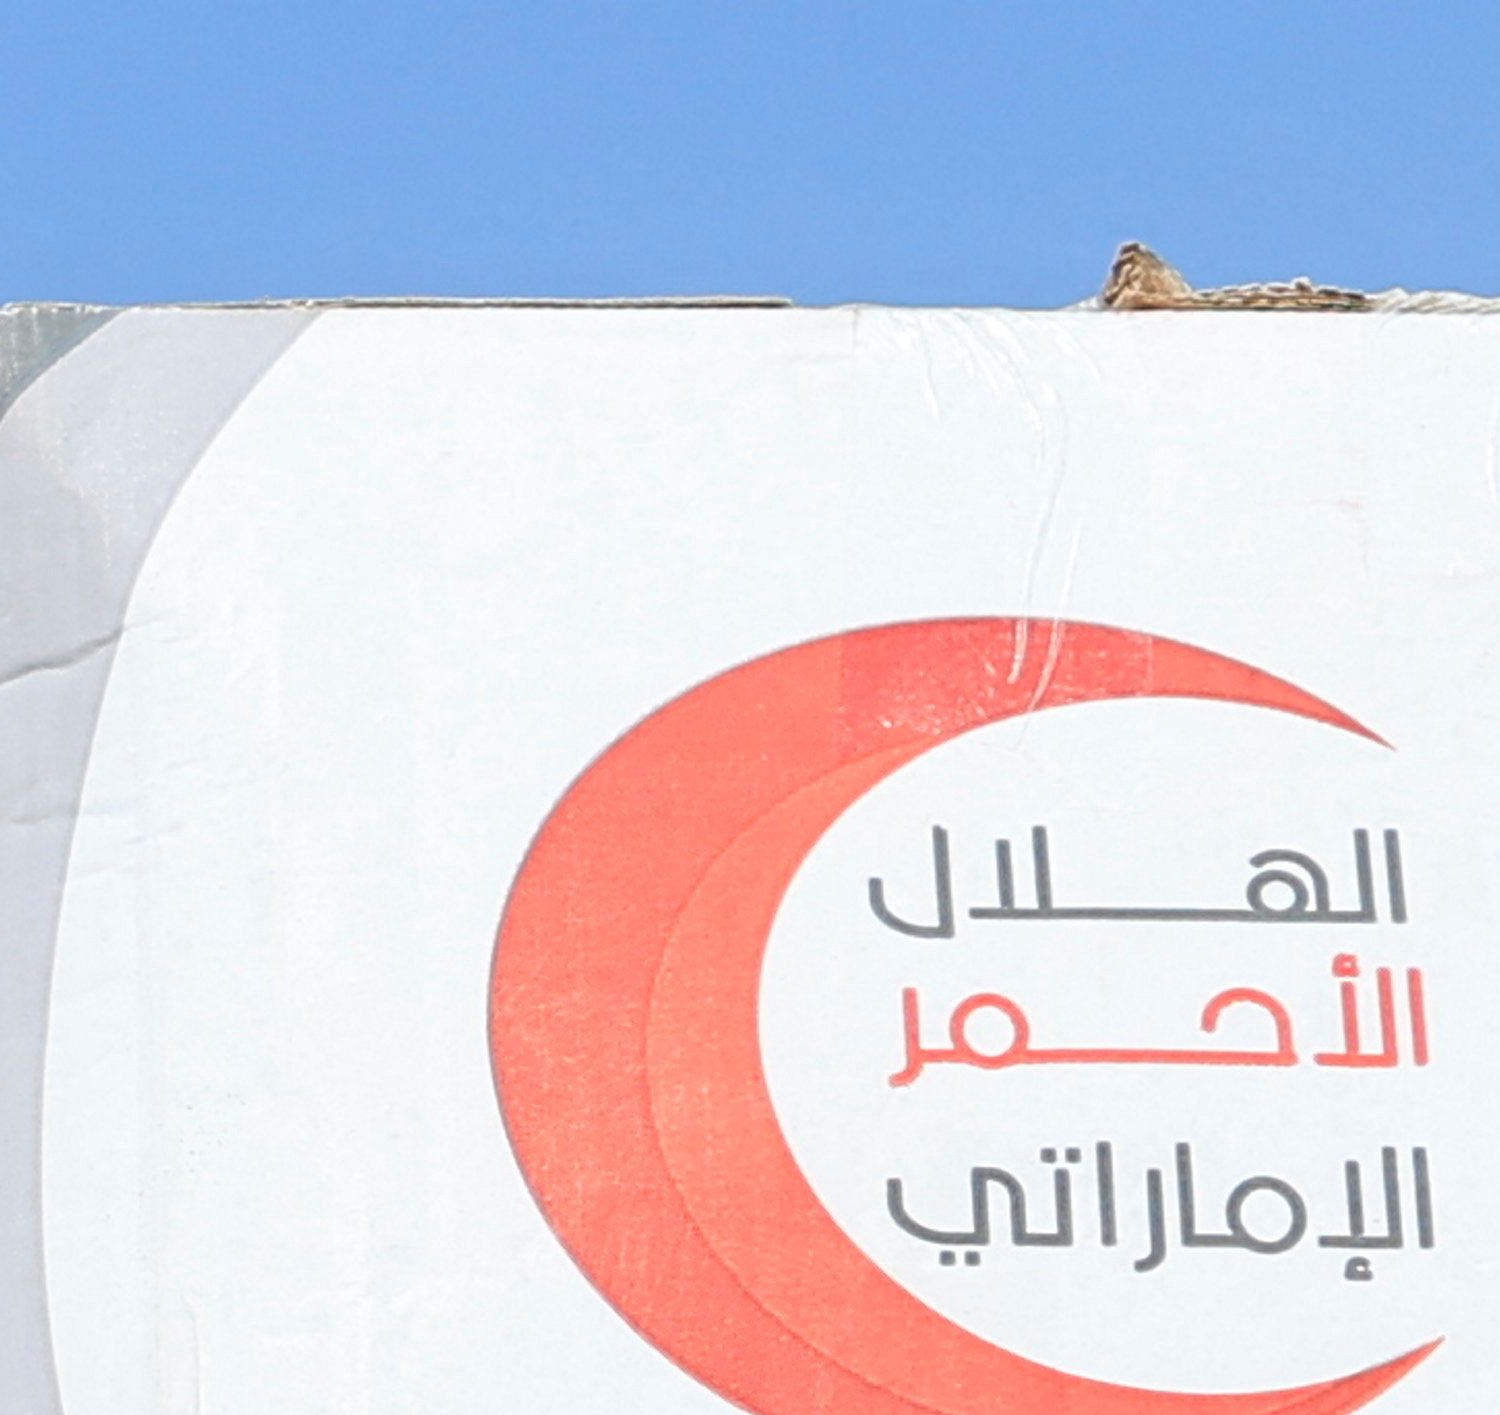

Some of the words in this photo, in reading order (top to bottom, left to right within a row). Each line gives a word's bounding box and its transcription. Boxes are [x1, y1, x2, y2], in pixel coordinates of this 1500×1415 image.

[868, 824, 1408, 939] الهلال
[888, 953, 1429, 1088] الأحمر
[886, 1140, 1435, 1281] الإماراتي
